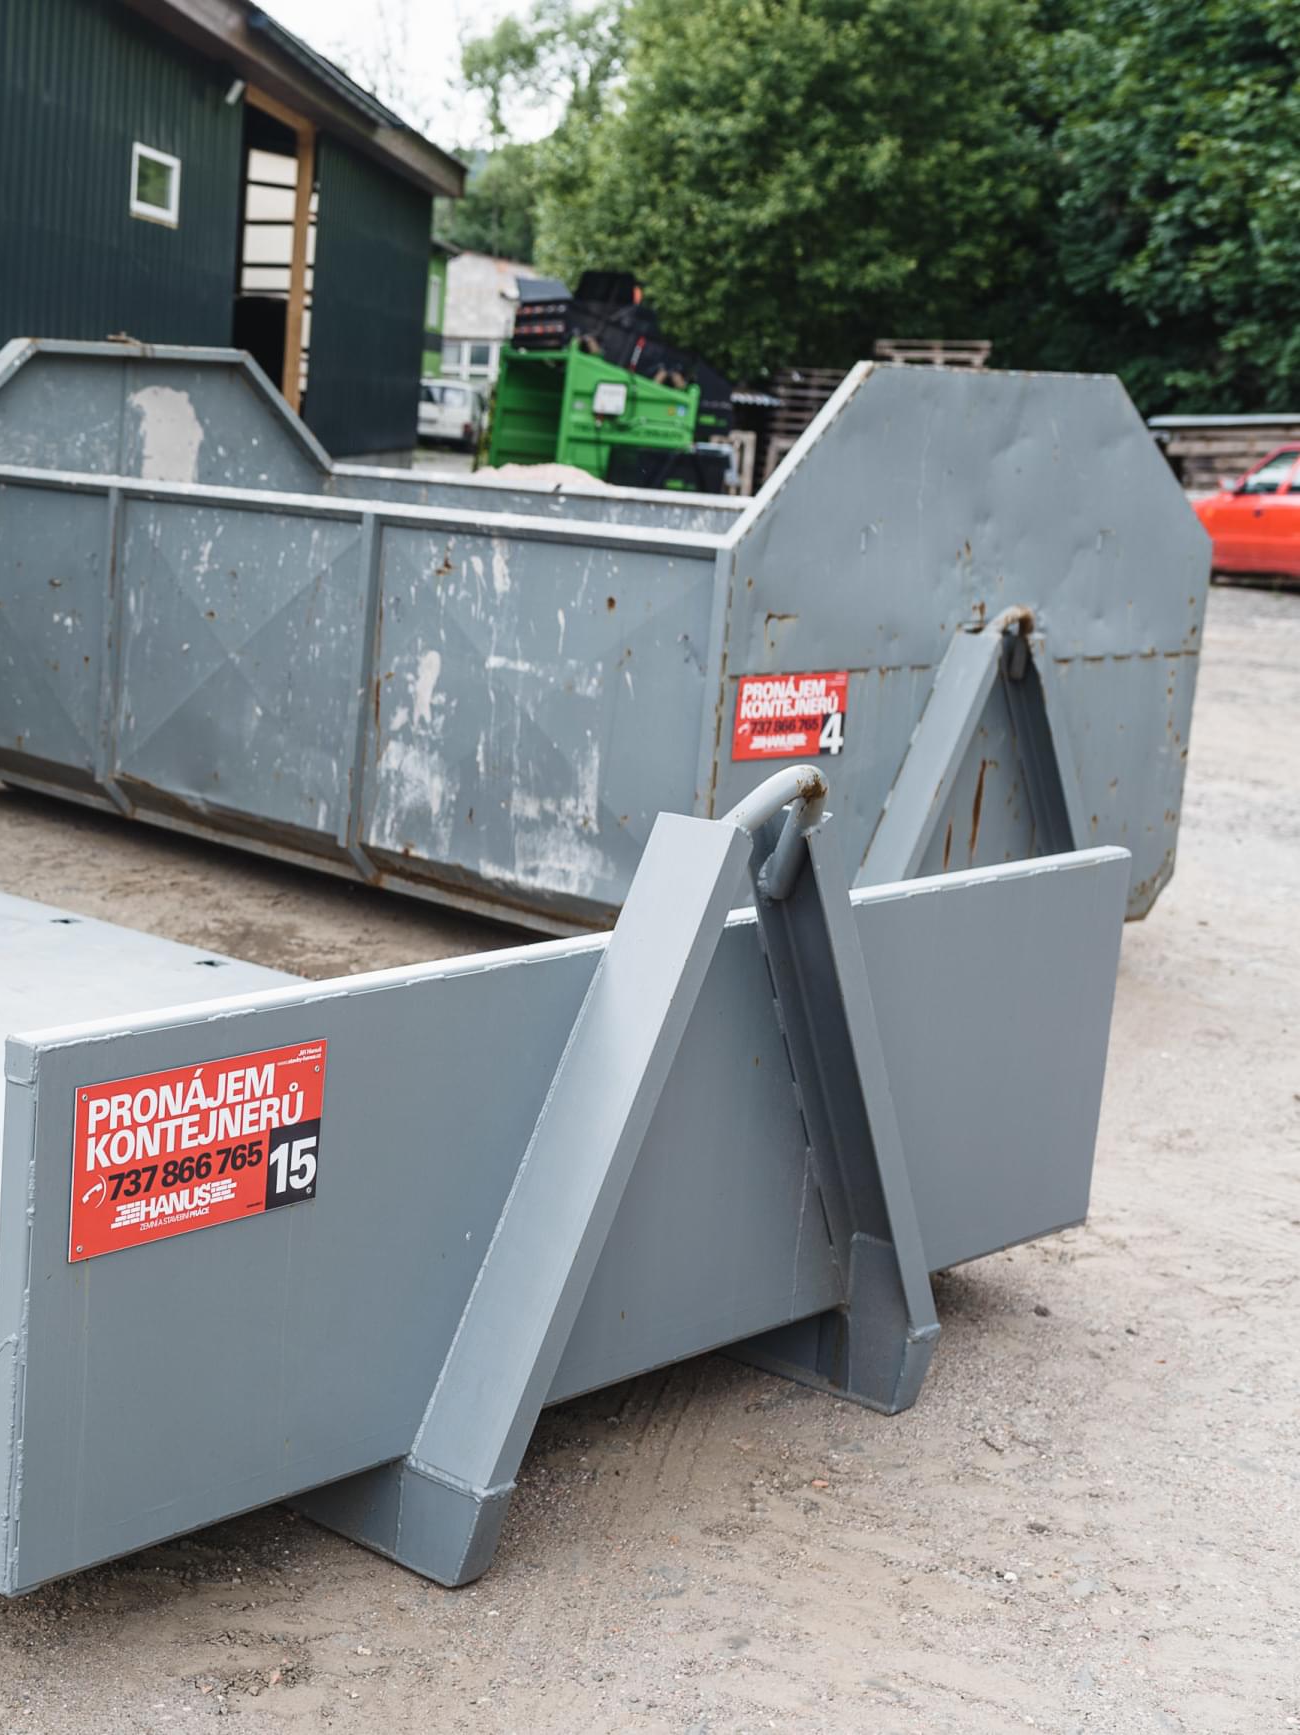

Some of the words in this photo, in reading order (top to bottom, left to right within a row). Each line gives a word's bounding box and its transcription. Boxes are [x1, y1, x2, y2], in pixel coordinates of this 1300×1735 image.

[740, 690, 839, 719] KONTEJNERŮ
[742, 676, 826, 701] PRONÁJEM
[819, 711, 844, 755] 4
[88, 1062, 276, 1135] PRONÁJEM
[86, 1082, 305, 1171] KONTEJNERŮ
[108, 1164, 159, 1201] 737
[160, 1151, 213, 1187] 866
[216, 1140, 264, 1175] 765
[269, 1136, 318, 1194] 15
[189, 1206, 210, 1217] PRÁCE
